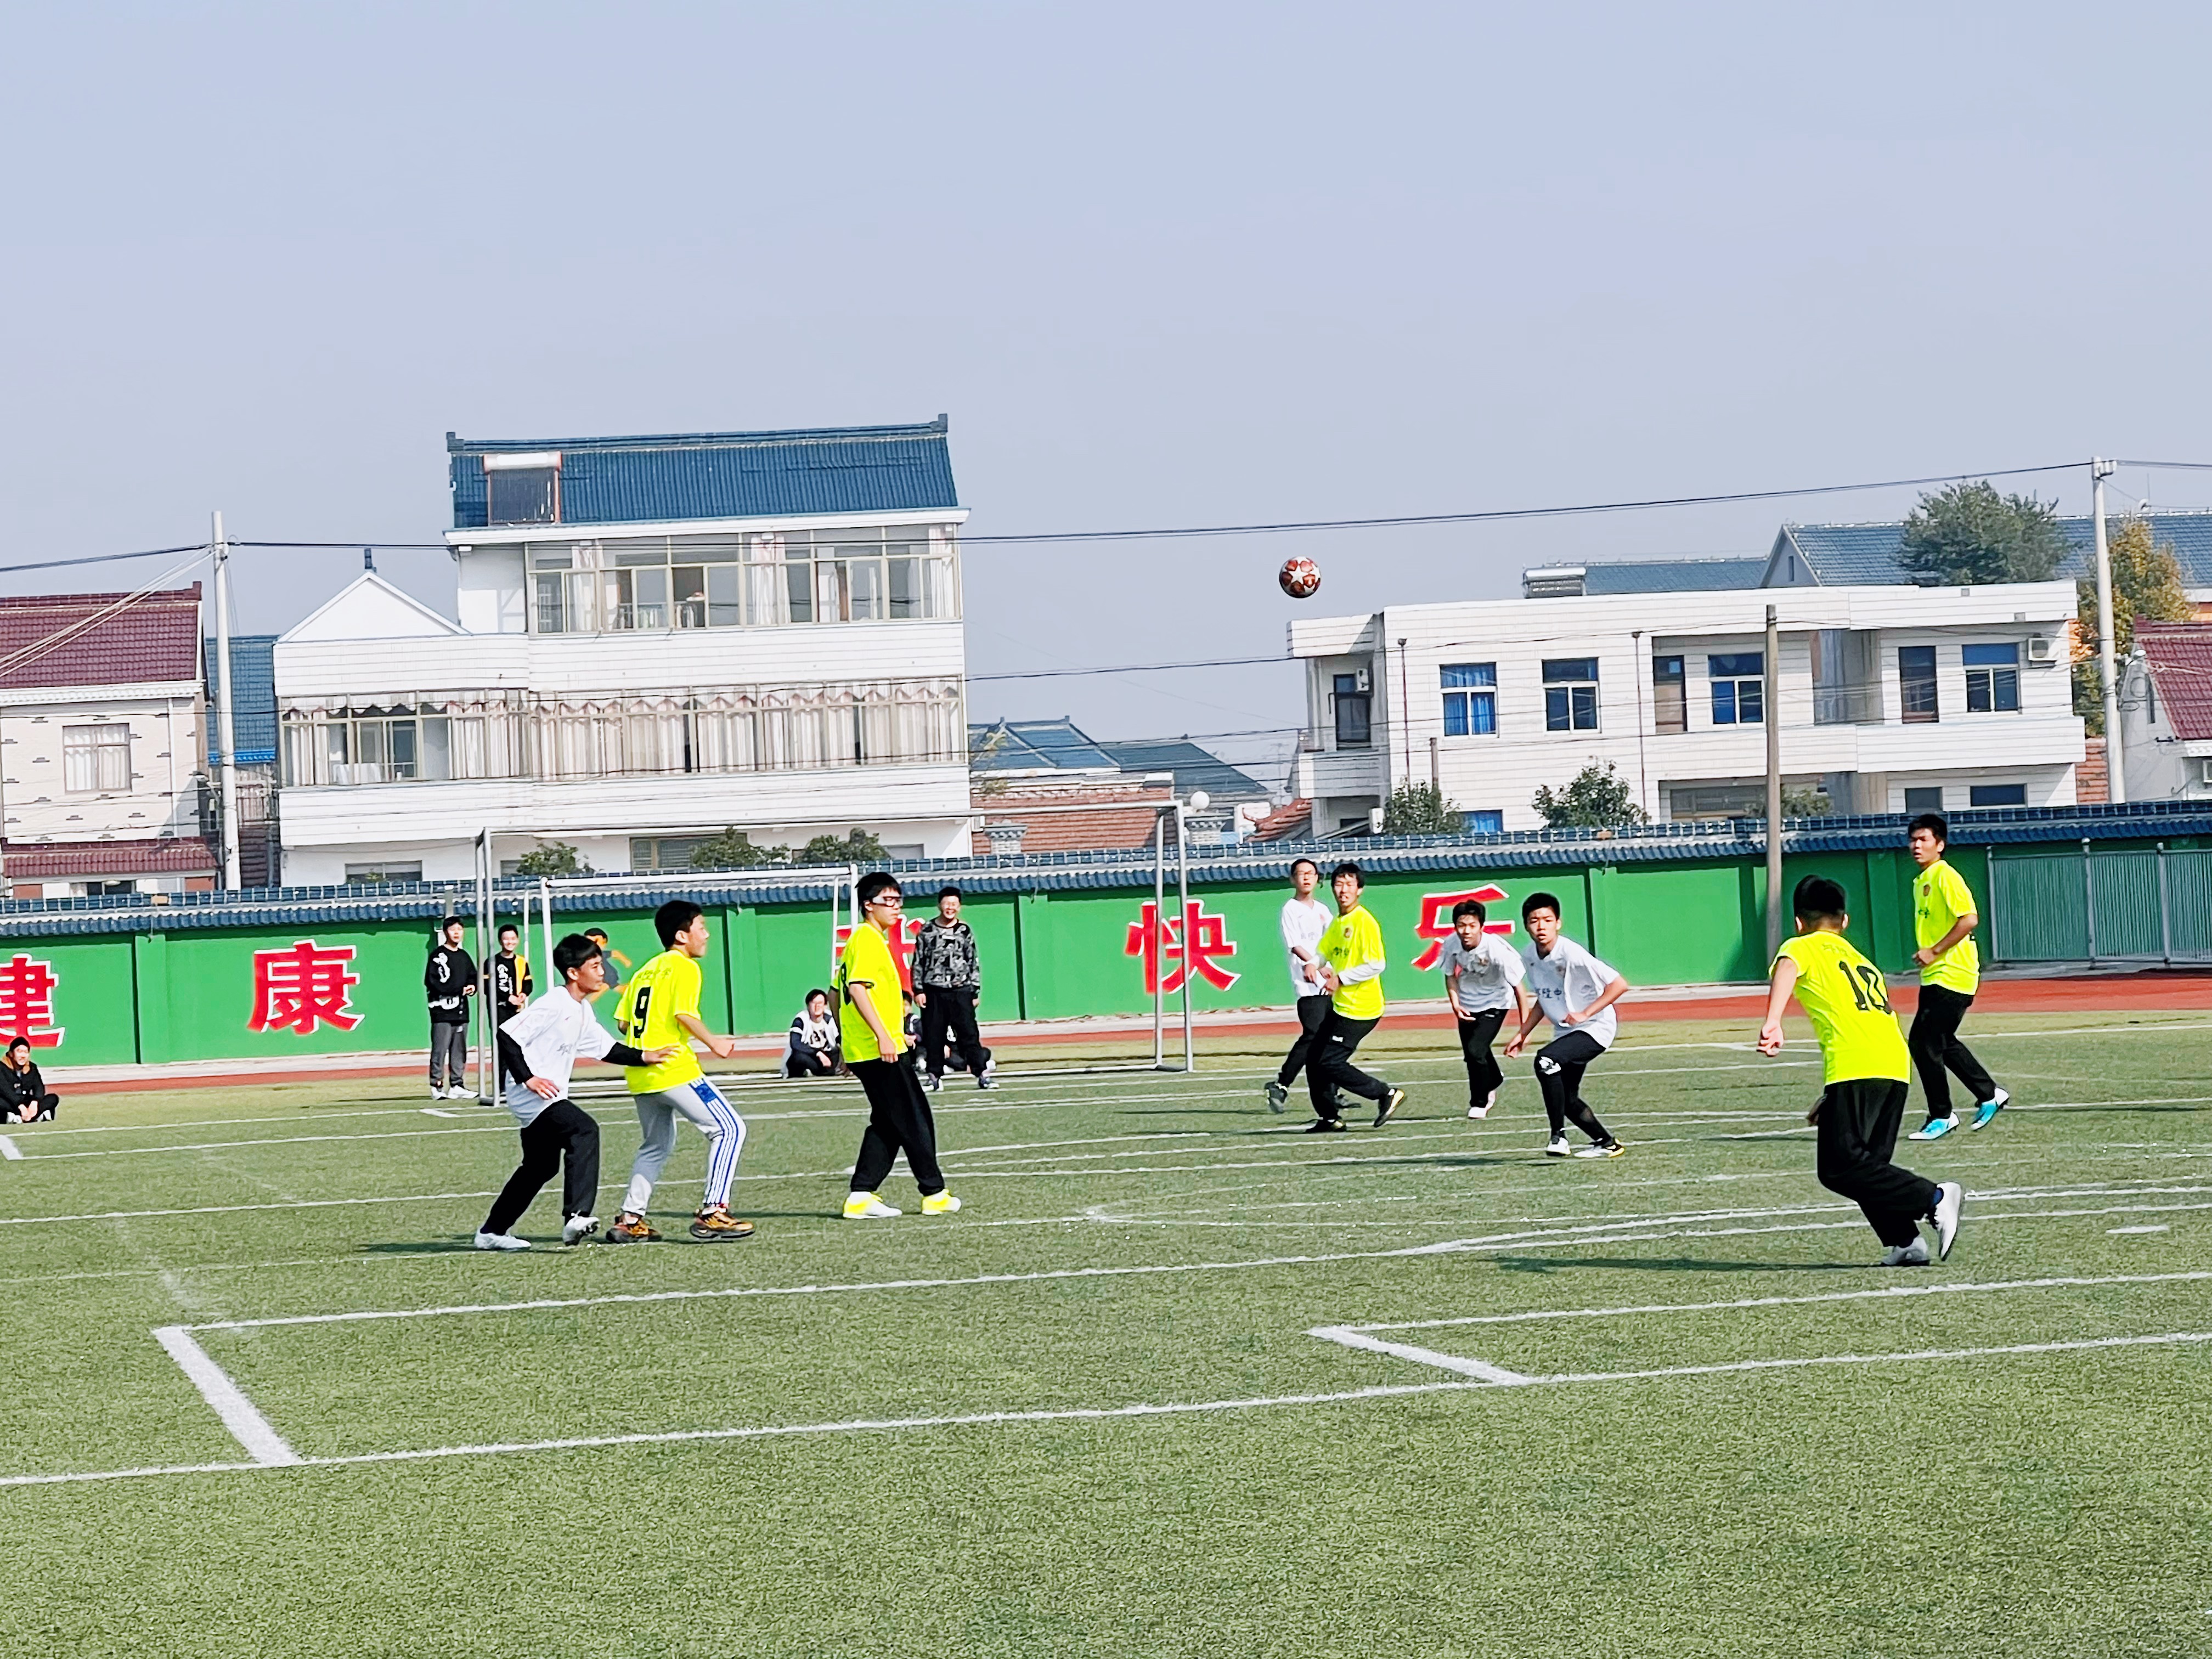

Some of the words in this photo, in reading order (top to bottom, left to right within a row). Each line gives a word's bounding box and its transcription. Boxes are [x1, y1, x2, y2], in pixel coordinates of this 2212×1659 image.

[247, 939, 365, 1036] 康
[1125, 899, 1242, 995] 快
[1839, 961, 1892, 1015] 10
[634, 986, 652, 1039] 9
